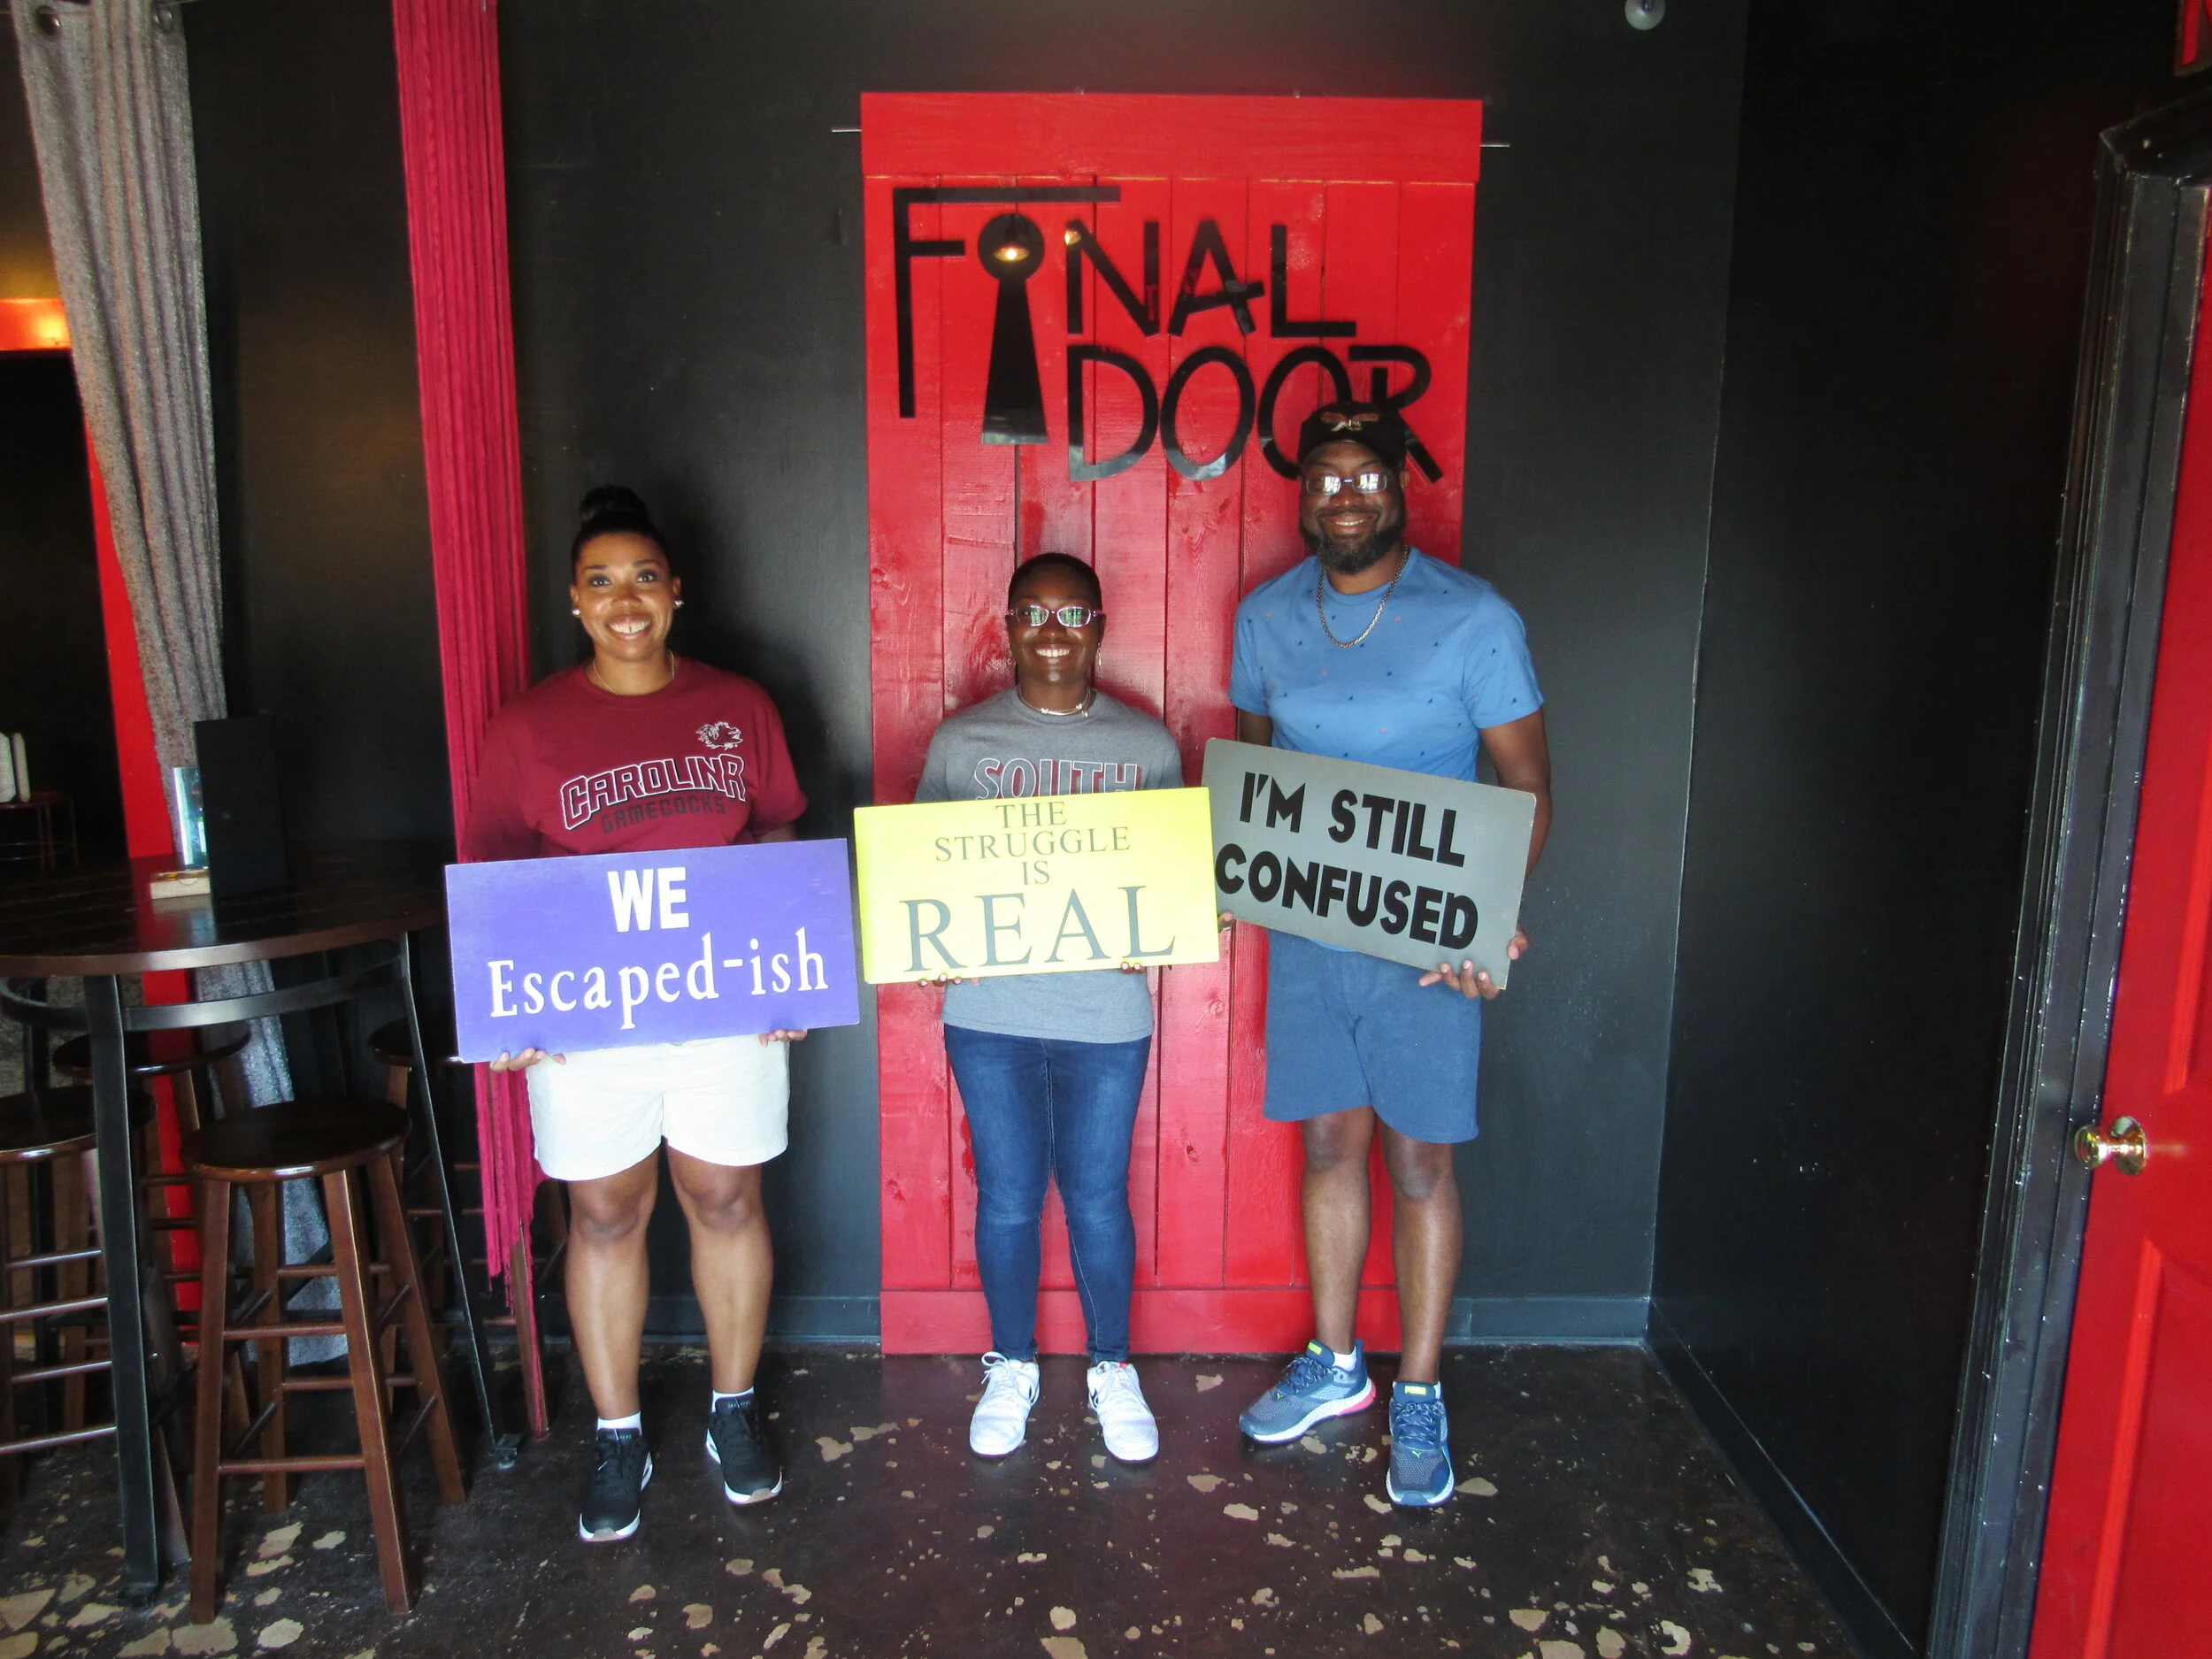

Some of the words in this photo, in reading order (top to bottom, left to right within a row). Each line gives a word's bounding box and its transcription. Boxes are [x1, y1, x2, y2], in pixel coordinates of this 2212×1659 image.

[1066, 345, 1444, 484] DOOR
[560, 753, 747, 831] CAROLINA
[602, 795, 727, 833] GAMECOCKS
[973, 757, 1142, 800] SOUTH
[935, 826, 1131, 862] STRUGGLE
[995, 801, 1067, 829] THE
[1240, 772, 1306, 833] I'M
[1327, 789, 1465, 868] STILL
[608, 866, 690, 933] WE
[1021, 860, 1051, 885] IS
[1215, 843, 1479, 950] CONFUSED
[899, 886, 1175, 972] REAL
[488, 926, 828, 1030] Escaped-ish
